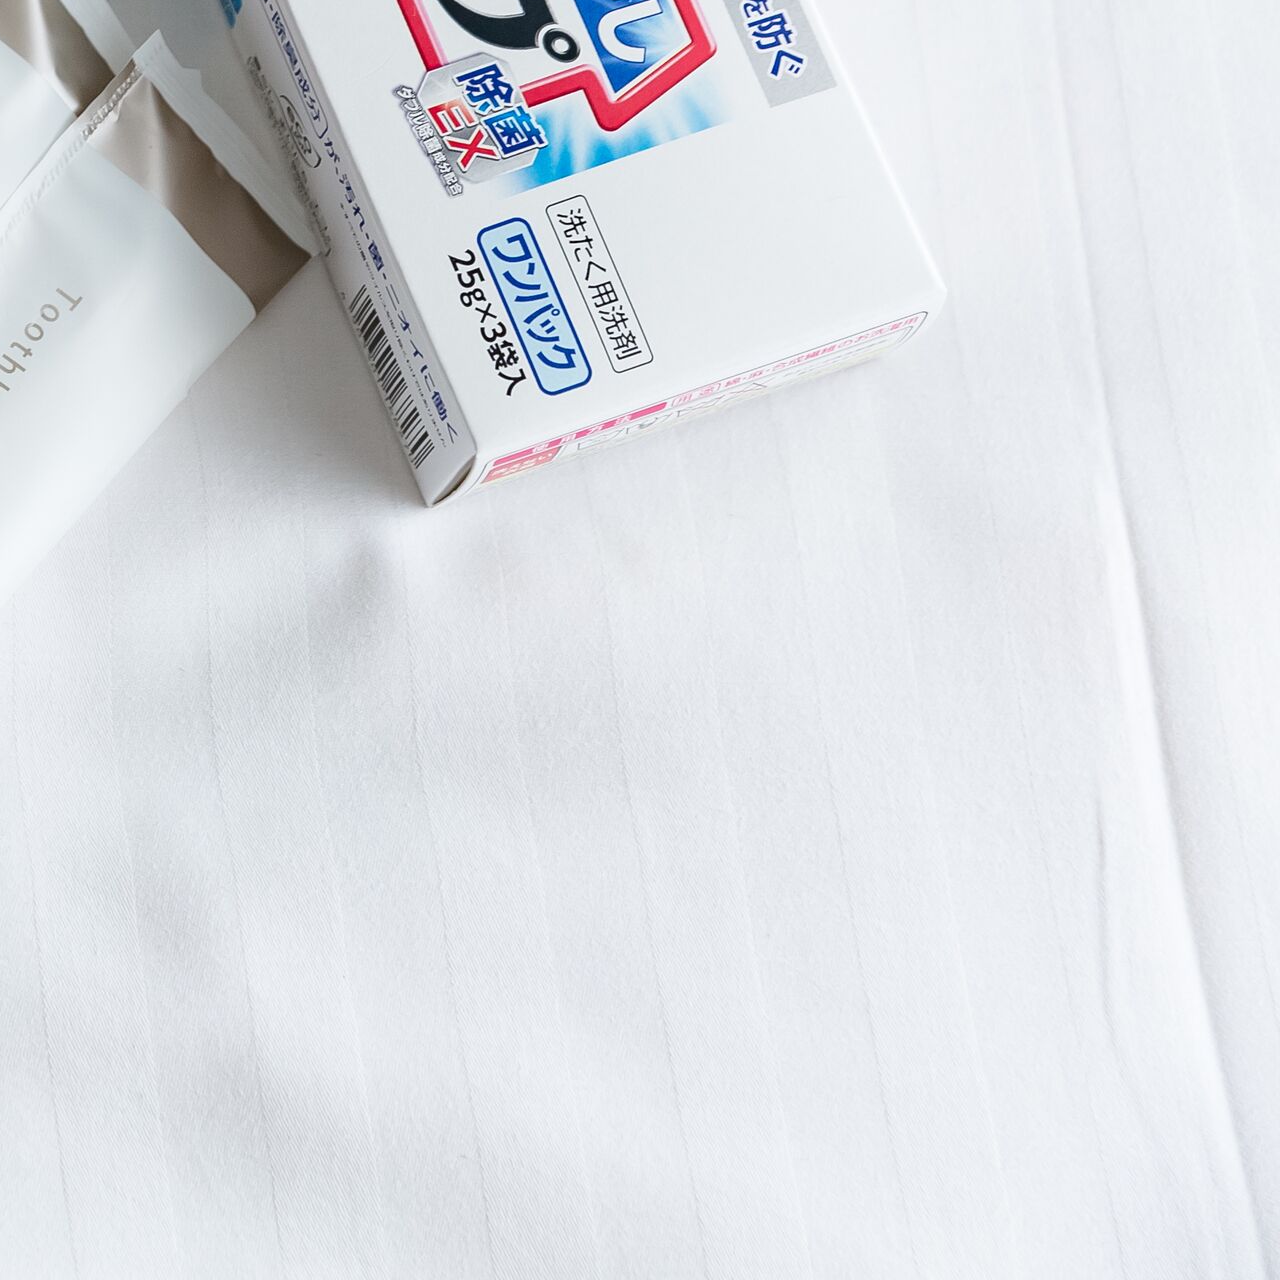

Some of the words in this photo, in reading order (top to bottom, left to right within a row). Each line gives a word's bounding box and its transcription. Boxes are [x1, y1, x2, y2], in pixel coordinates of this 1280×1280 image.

[425, 95, 497, 174] EX
[455, 61, 548, 159] 除菌
[447, 248, 526, 397] 25g×3袋入
[490, 232, 576, 370] ワンパック
[555, 205, 641, 361] 洗たく用洗剤
